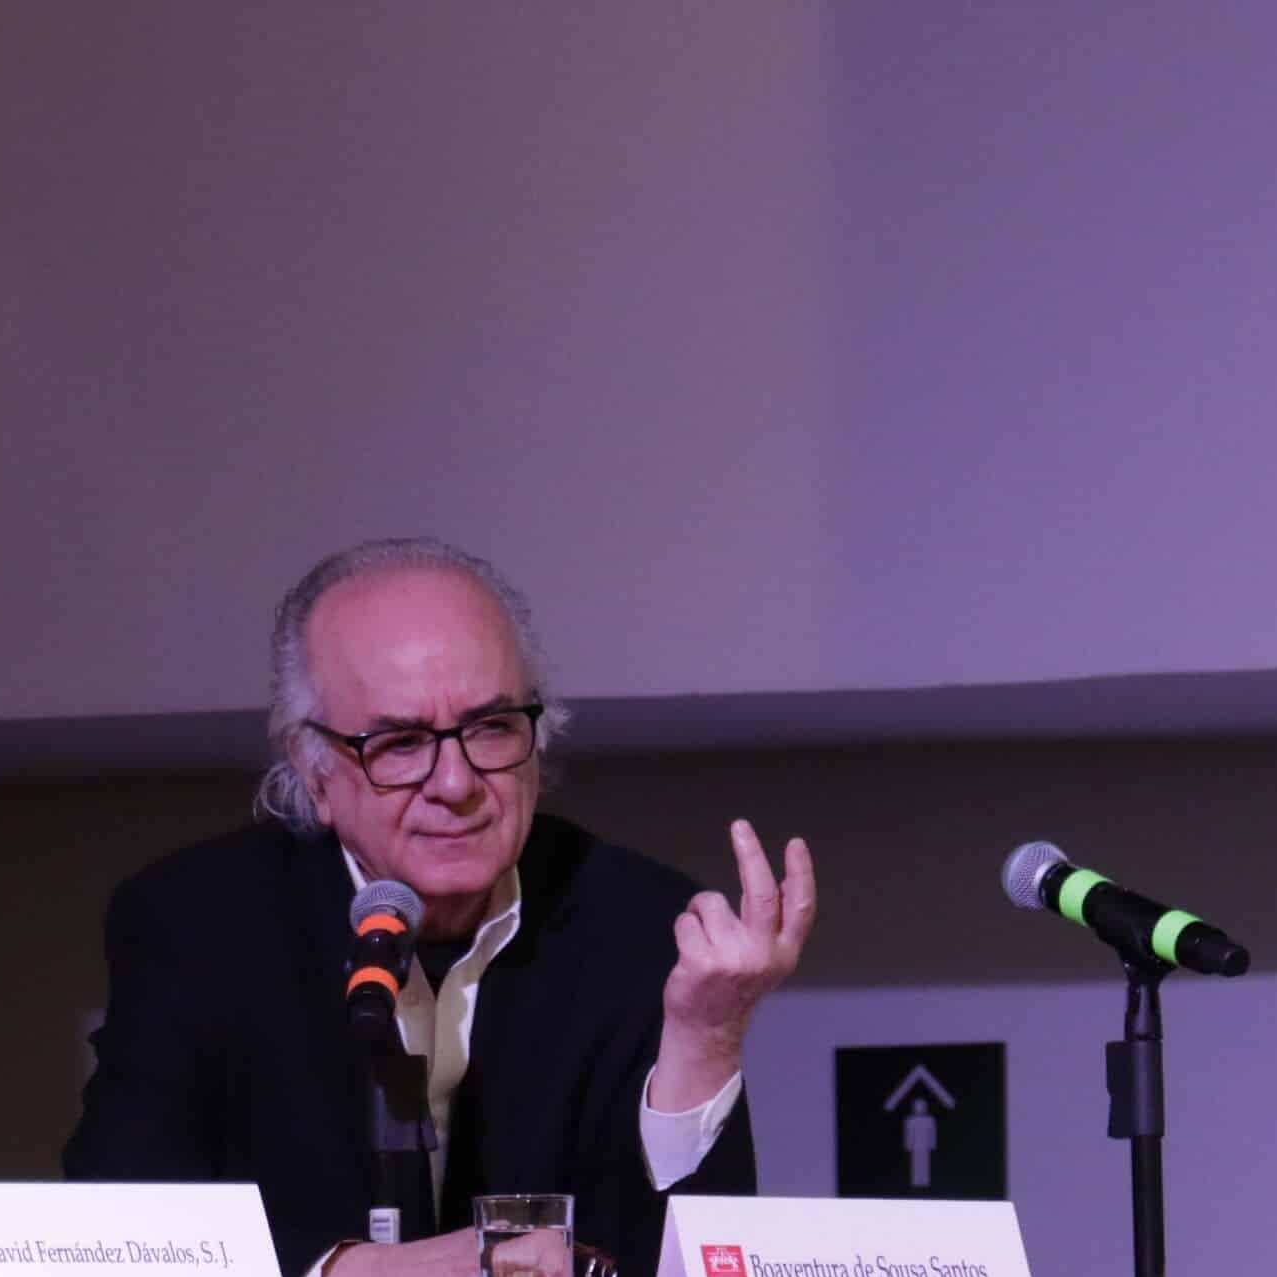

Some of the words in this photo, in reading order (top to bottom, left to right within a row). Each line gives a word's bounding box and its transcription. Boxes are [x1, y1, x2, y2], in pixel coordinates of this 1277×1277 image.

[35, 1240, 124, 1264] Fernández
[125, 1240, 200, 1267] Dávalos,
[201, 1241, 218, 1264] S.
[219, 1241, 234, 1269] J.
